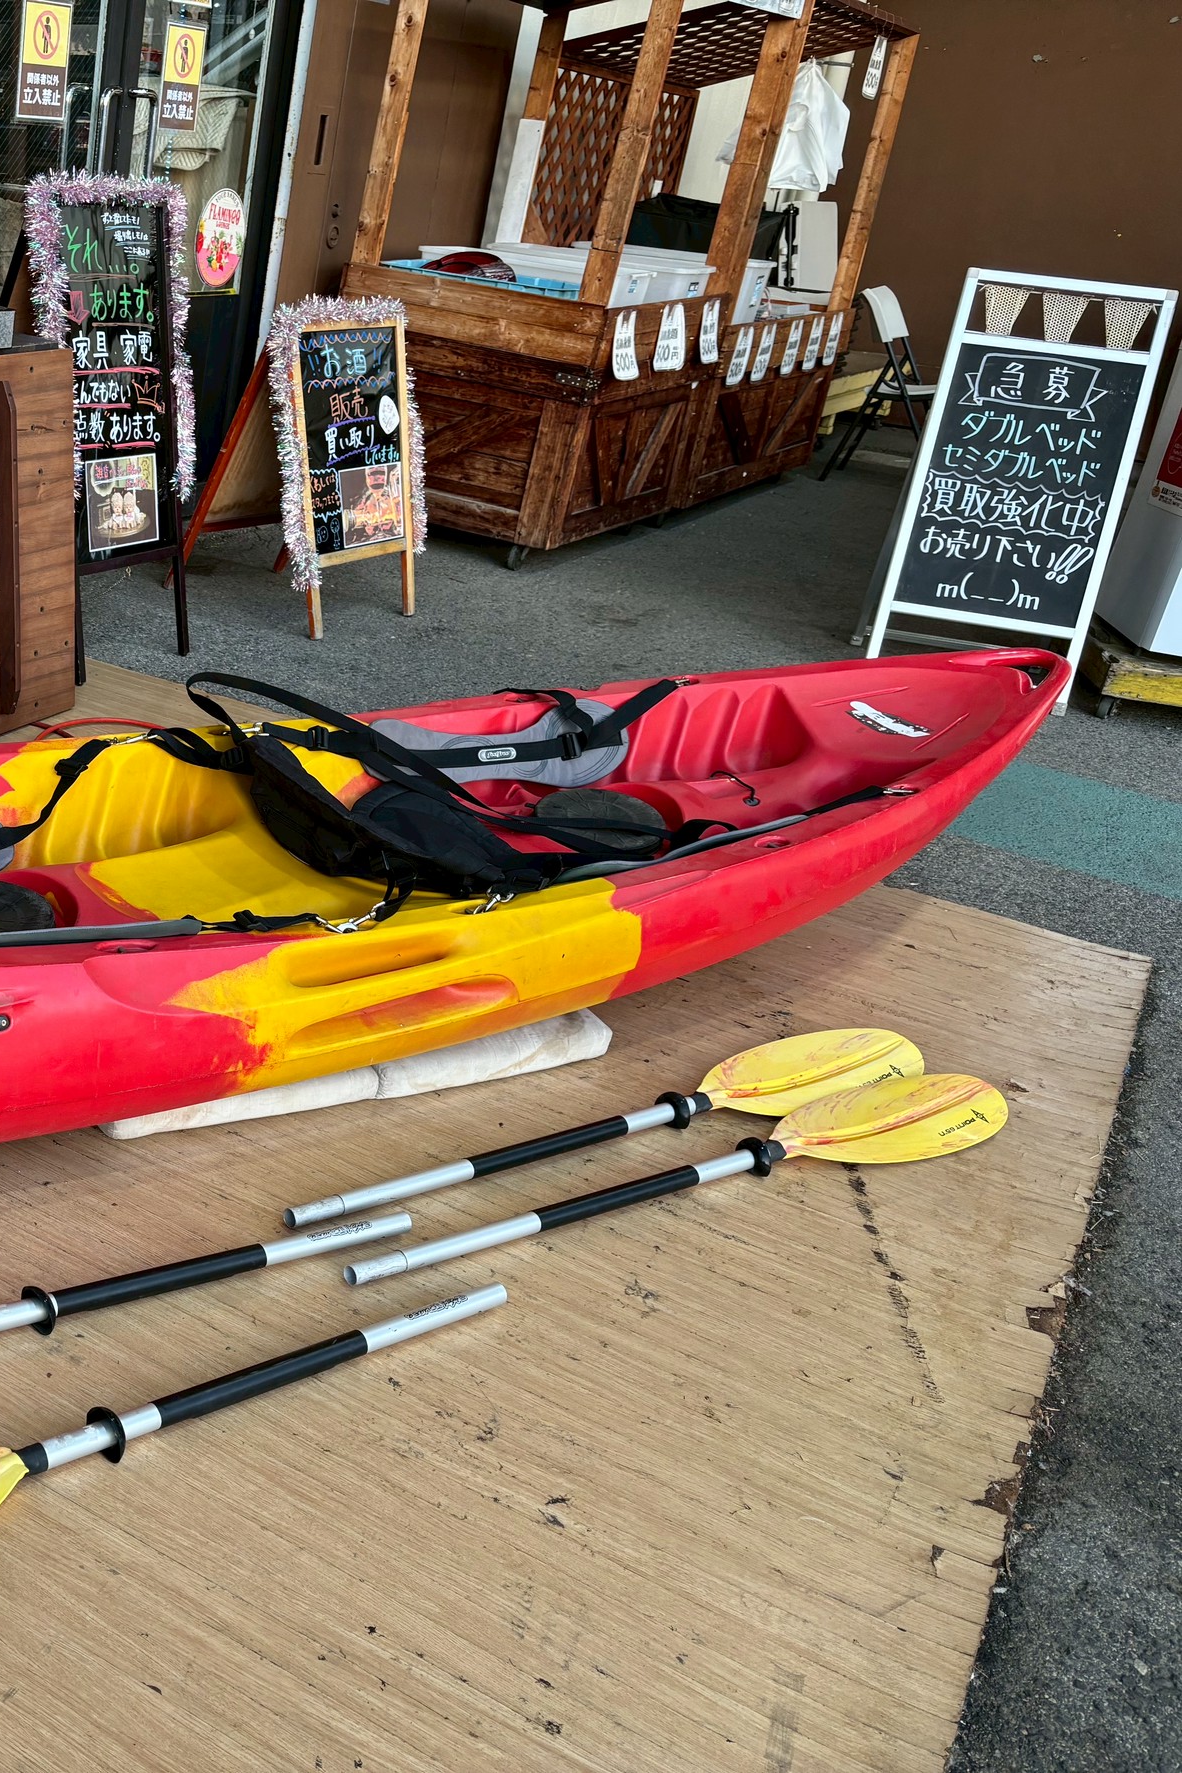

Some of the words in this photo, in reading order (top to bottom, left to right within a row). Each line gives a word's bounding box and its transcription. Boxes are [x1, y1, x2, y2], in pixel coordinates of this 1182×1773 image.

[22, 86, 61, 106] 立入禁止
[26, 72, 60, 86] 関係者以外
[166, 89, 193, 102] 関係者以外
[161, 102, 194, 120] 立入禁止
[989, 361, 1076, 405] 急募
[328, 386, 369, 424] 販売
[324, 423, 376, 462] 買い取り
[960, 410, 1103, 456] ダブルベッド
[941, 443, 1102, 488] セミダブルベッド
[931, 476, 1096, 536] 買取強化中
[955, 1117, 976, 1130] POINT
